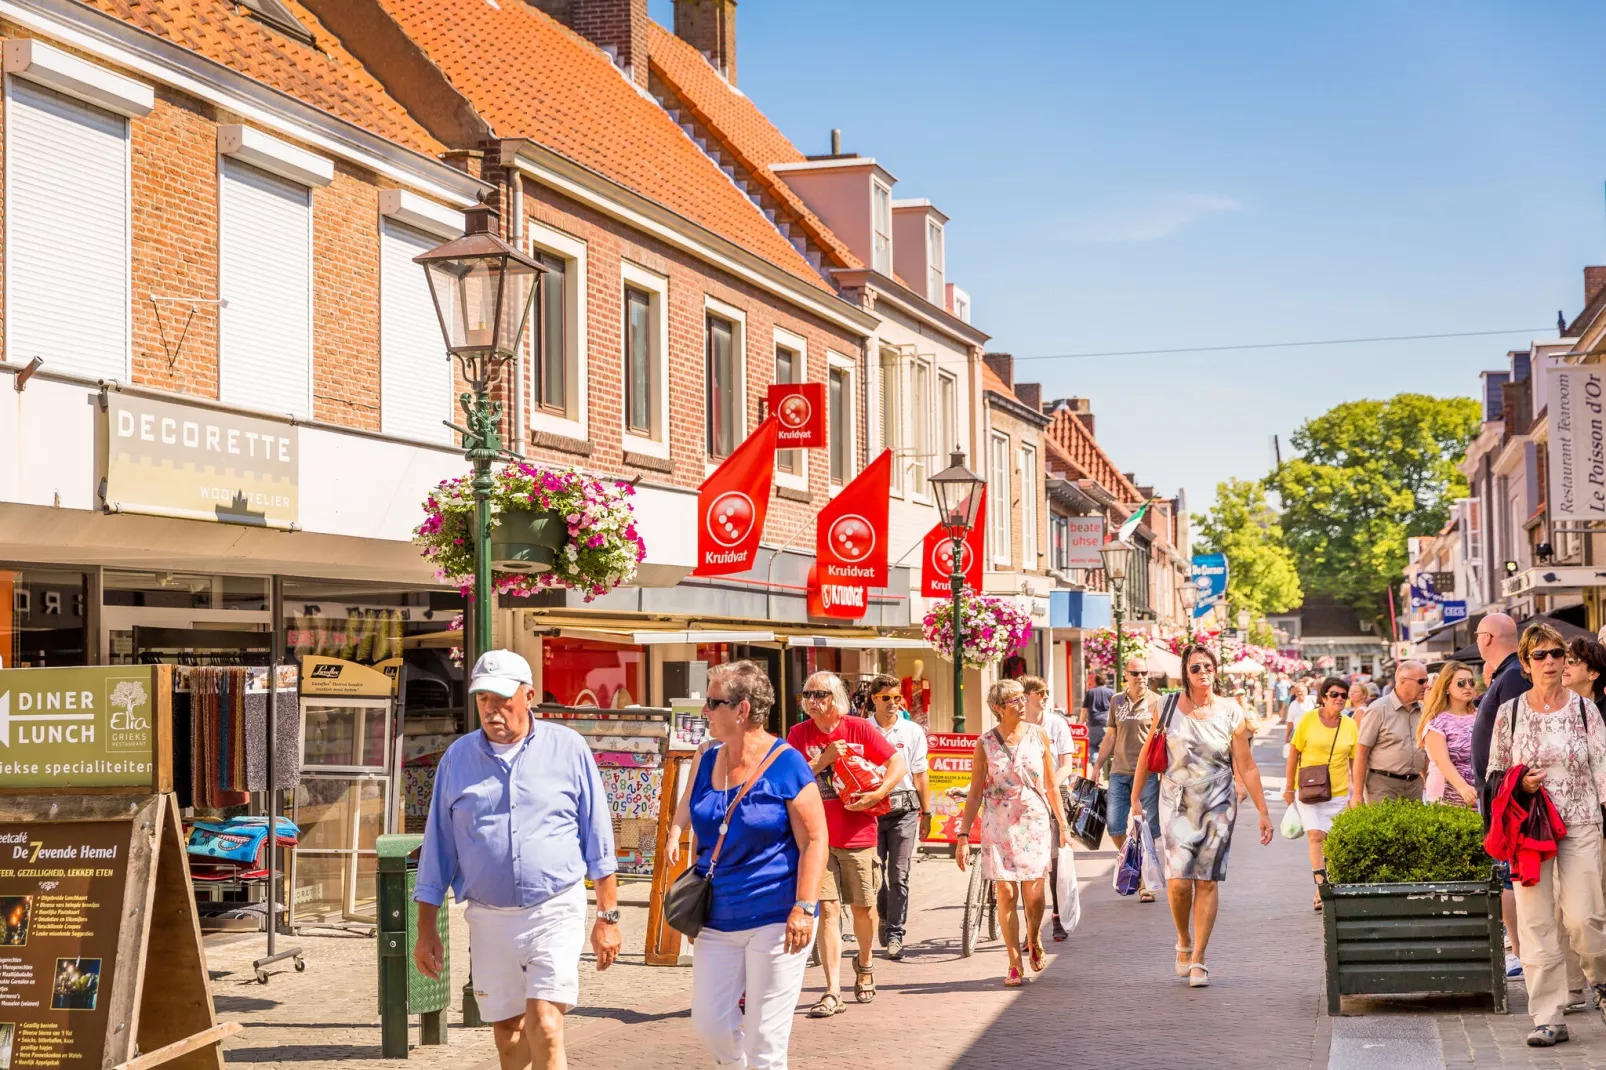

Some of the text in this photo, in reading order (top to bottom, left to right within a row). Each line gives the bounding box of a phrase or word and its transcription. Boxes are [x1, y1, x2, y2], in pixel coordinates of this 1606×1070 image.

[118, 409, 291, 463] DECORETTE
[778, 430, 811, 439] Kruidvat
[1558, 374, 1574, 513] Restaurant Tearoom
[1585, 373, 1606, 513] Le Poisson d'Or
[200, 485, 291, 508] WOONATELIER
[1070, 522, 1101, 533] beate
[1072, 536, 1099, 546] uhse
[705, 550, 747, 565] Kruidvat
[828, 565, 875, 578] Kruidvat
[19, 691, 94, 710] DINER
[110, 711, 151, 730] Elia
[18, 725, 95, 743] LUNCH
[112, 733, 147, 741] GRIEKS
[939, 736, 977, 748] Kruidva
[45, 760, 152, 776] specialiteiten
[13, 845, 29, 859] De
[80, 845, 118, 859] Hemel
[18, 868, 66, 878] GEZELLIGHEID,
[68, 868, 95, 877] LEKKER
[95, 868, 114, 877] ETEN
